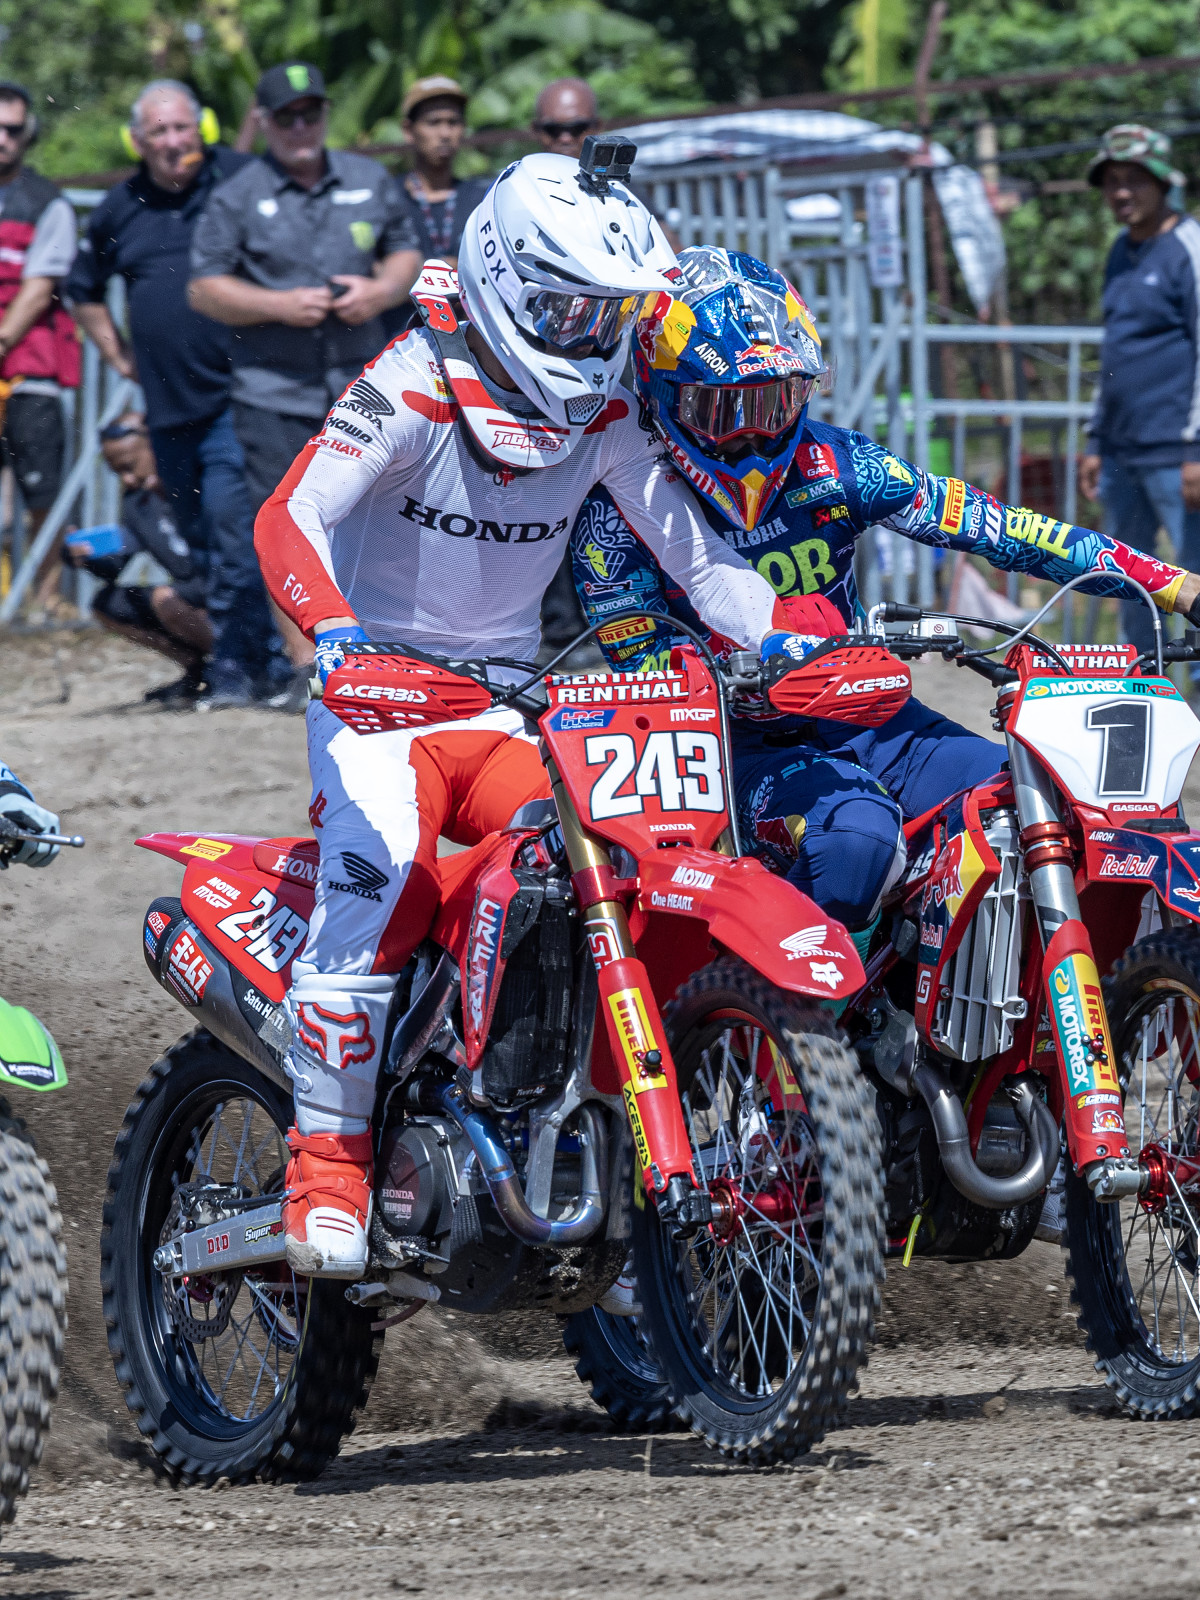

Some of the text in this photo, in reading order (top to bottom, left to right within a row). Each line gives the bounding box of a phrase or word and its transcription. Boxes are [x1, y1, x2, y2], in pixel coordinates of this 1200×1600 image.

[480, 220, 507, 282] FOX
[694, 342, 730, 377] AIROH
[737, 357, 804, 375] Red Bull
[398, 495, 568, 543] HONDA
[967, 496, 983, 539] BRISK
[724, 516, 789, 549] ALOHA
[748, 538, 837, 597] OR
[595, 595, 638, 615] MOTOREX
[1032, 655, 1131, 669] RENTHAL
[334, 683, 428, 705] ACERBIS
[557, 682, 690, 704] RENTHAL
[836, 674, 910, 697] ACERBIS
[1050, 680, 1177, 697] MOTOREX MXGP
[561, 710, 604, 727] HRC
[670, 708, 716, 722] MXGP
[1087, 699, 1151, 796] 1
[584, 730, 725, 823] 243
[1112, 804, 1156, 812] GASGAS
[650, 823, 696, 832] HONDA
[1088, 830, 1115, 842] AIROH
[272, 855, 320, 883] HON
[671, 865, 716, 889] MOTUL
[1099, 853, 1158, 877] Red Bull
[193, 885, 232, 909] MXGP
[207, 876, 241, 900] MOTUL
[328, 880, 382, 903] HONDA
[651, 891, 693, 911] One HEART.
[216, 886, 309, 973] 243
[473, 898, 501, 963] CRF
[786, 949, 847, 961] HONDA
[243, 988, 263, 1014] Satu
[1058, 994, 1090, 1090] MOTOREX
[623, 1086, 649, 1168] ACERBIS
[382, 1188, 414, 1201] HONDA
